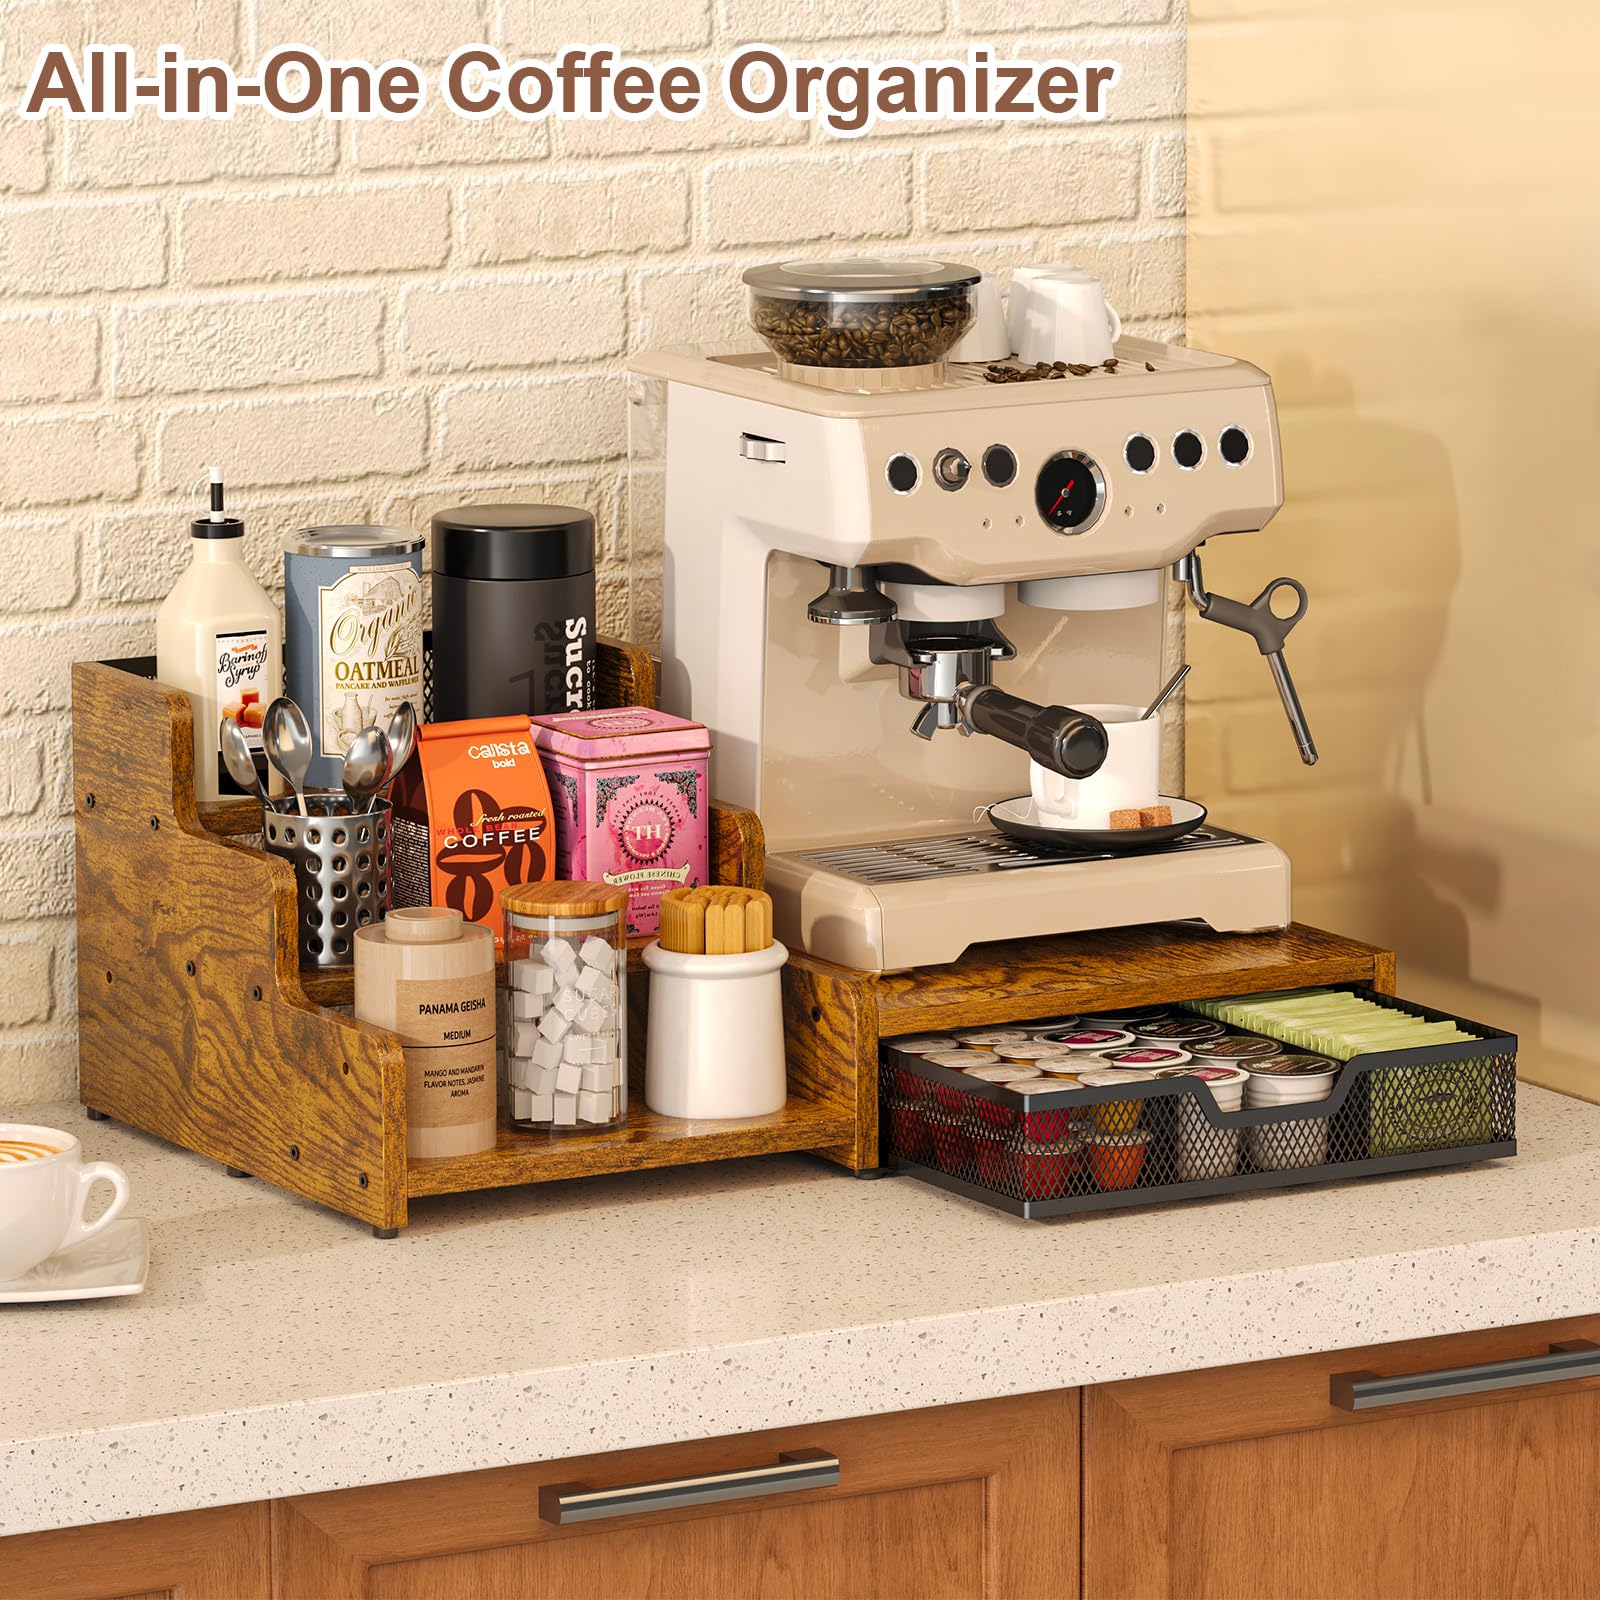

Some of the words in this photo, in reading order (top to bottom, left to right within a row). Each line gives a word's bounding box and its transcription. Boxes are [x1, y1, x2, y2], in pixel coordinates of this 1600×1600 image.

[330, 585, 417, 658] Organic
[217, 643, 268, 673] Barinoff
[565, 617, 587, 712] Sucr
[225, 660, 261, 688] Syrup
[335, 656, 420, 681] OATMEAL
[335, 682, 370, 690] PANCAKE
[371, 681, 388, 689] AND
[492, 758, 516, 769] bold
[470, 812, 506, 828] fresh
[507, 807, 546, 821] roasted
[436, 825, 480, 836] WHOLE
[486, 822, 518, 832] BEAN
[444, 827, 541, 850] COFFEE
[420, 1003, 459, 1015] PANAMA
[460, 997, 486, 1012] GEISHA
[443, 1029, 471, 1040] MEDIUM
[448, 1068, 459, 1076] AND
[460, 1064, 485, 1074] MANDARIN
[423, 1080, 446, 1088] FLAVOR
[466, 1074, 485, 1084] JASMINE
[450, 1089, 469, 1098] AROMA
